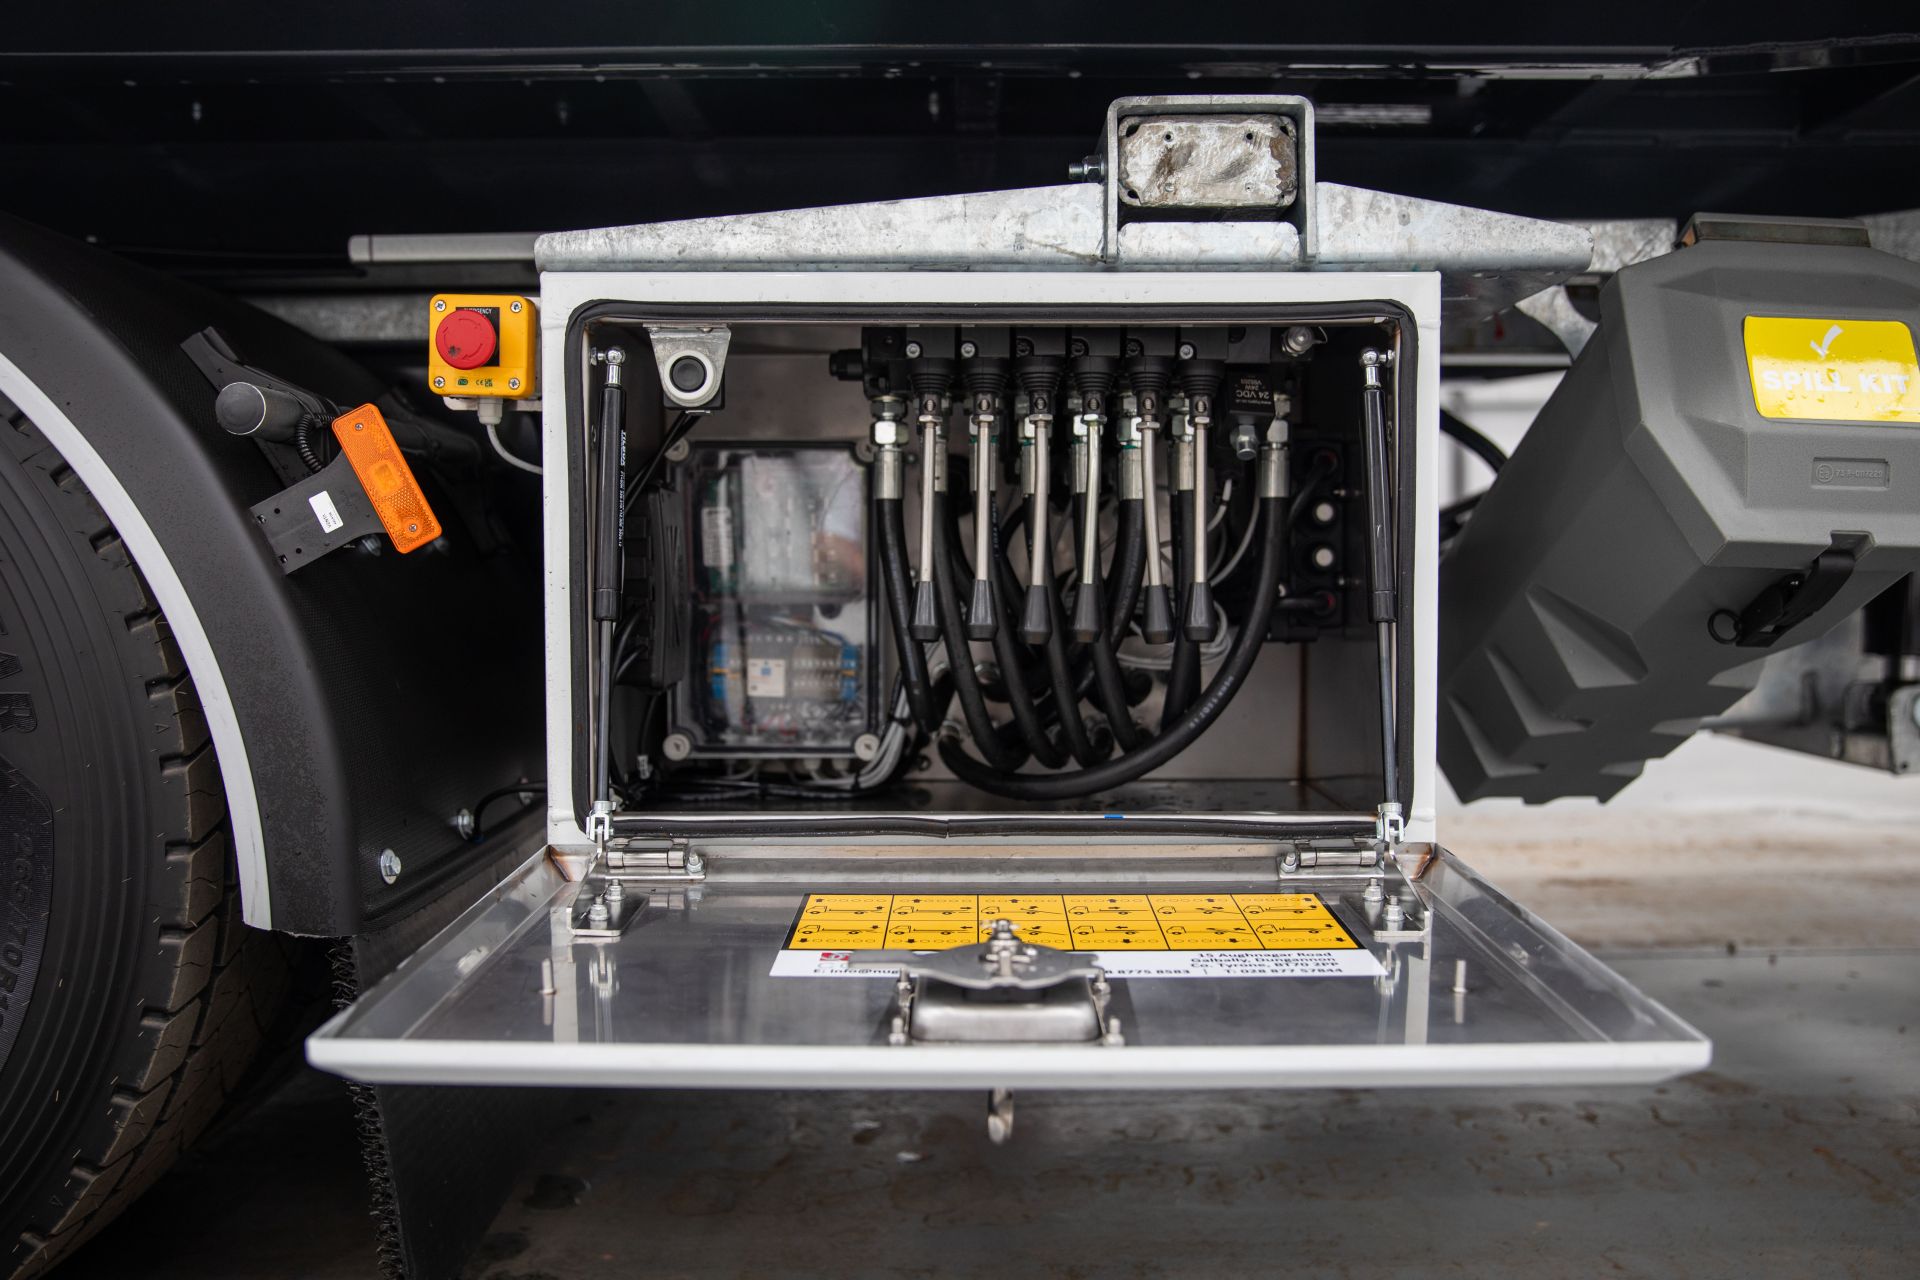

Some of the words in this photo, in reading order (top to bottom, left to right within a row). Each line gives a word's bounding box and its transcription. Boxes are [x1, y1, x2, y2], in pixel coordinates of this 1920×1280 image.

[1762, 370, 1851, 392] SPILL
[1858, 373, 1910, 393] KIT
[1236, 389, 1257, 398] VDC
[1259, 391, 1270, 399] 24
